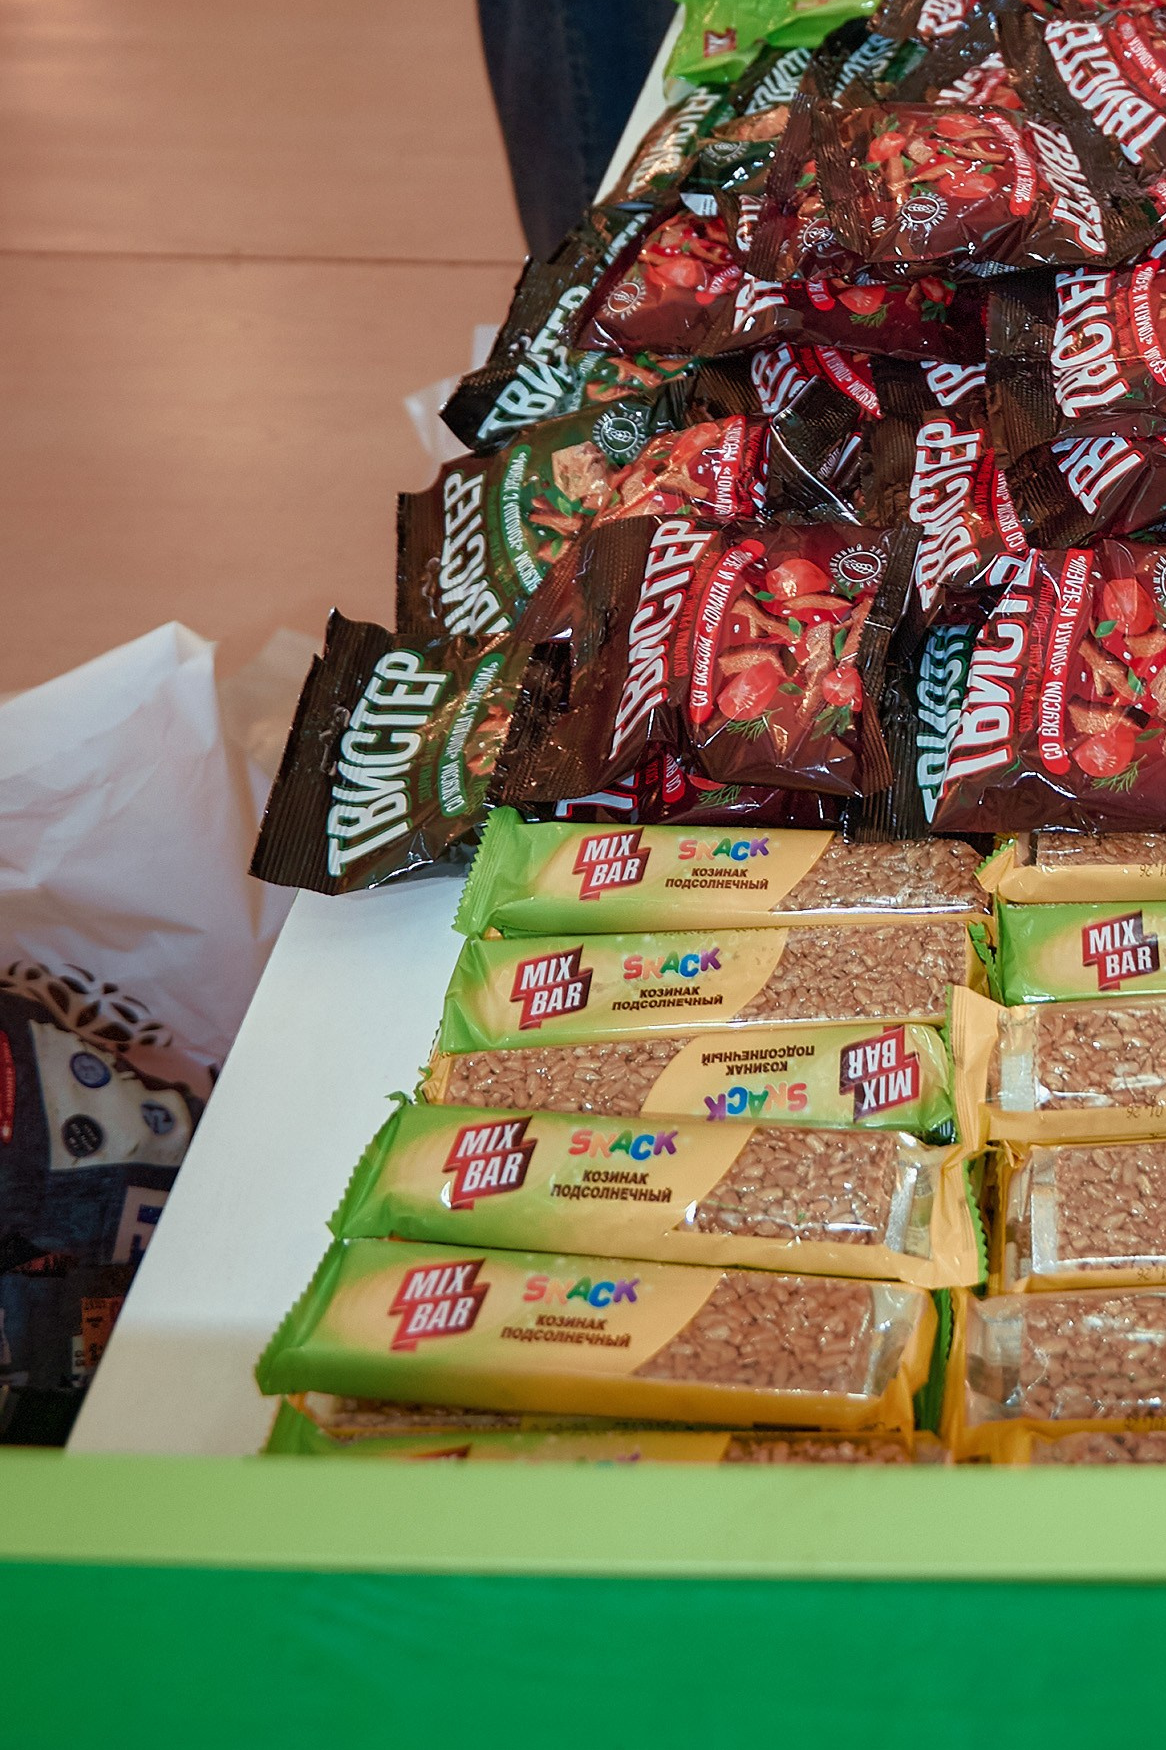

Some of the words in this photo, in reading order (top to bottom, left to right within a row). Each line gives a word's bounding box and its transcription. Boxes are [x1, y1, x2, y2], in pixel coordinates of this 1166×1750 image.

[1135, 303, 1156, 345] «ТОМАТА
[908, 421, 983, 613] ТВИСТЕР
[996, 500, 1020, 533] ВКУСОМ
[1008, 530, 1025, 549] СО
[1064, 554, 1088, 604] ЗЕЛЕНИ»
[698, 579, 730, 635] «ТОМАТА
[609, 520, 717, 760] ТВИСТЕР
[1051, 617, 1075, 676] «ТОМАТА
[690, 634, 714, 688] ВКУСОМ
[691, 686, 709, 708] СО
[1042, 680, 1062, 738] ВКУСОМ
[329, 650, 449, 876] ТВИСТЕР
[1043, 738, 1061, 760] СО
[581, 833, 635, 862] MIX
[677, 837, 769, 861] SNACK
[589, 859, 640, 887] BAR
[665, 877, 769, 891] ПОДСОЛНЕЧНЫЙ
[691, 867, 749, 878] КОЗИНАК
[1089, 921, 1136, 950] MIX
[521, 954, 572, 987] MIX
[623, 947, 722, 981] SNACK
[1105, 944, 1152, 977] BAR
[530, 981, 583, 1013] BAR
[612, 994, 724, 1011] ПОДСОЛНЕЧНЫЙ
[640, 986, 700, 998] КОЗИНАК
[701, 1045, 815, 1067] ПОДСОЛНЕЧНЫЙ
[725, 1061, 788, 1076] КОЗИНАК
[847, 1040, 897, 1073] BAR
[704, 1082, 807, 1121] SNACK
[861, 1079, 913, 1112] MIX
[456, 1125, 516, 1156] MIX
[568, 1129, 678, 1161] SNACK
[463, 1152, 521, 1191] BAR
[582, 1170, 649, 1184] КОЗИНАК
[550, 1183, 672, 1203] ПОДСОЛНЕЧНЫЙ
[405, 1265, 472, 1297] MIX
[523, 1275, 640, 1308] SNACK
[410, 1296, 475, 1332] BAR
[536, 1315, 607, 1330] КОЗИНАК
[501, 1326, 631, 1348] ПОДСОЛНЕЧНЫЙ
